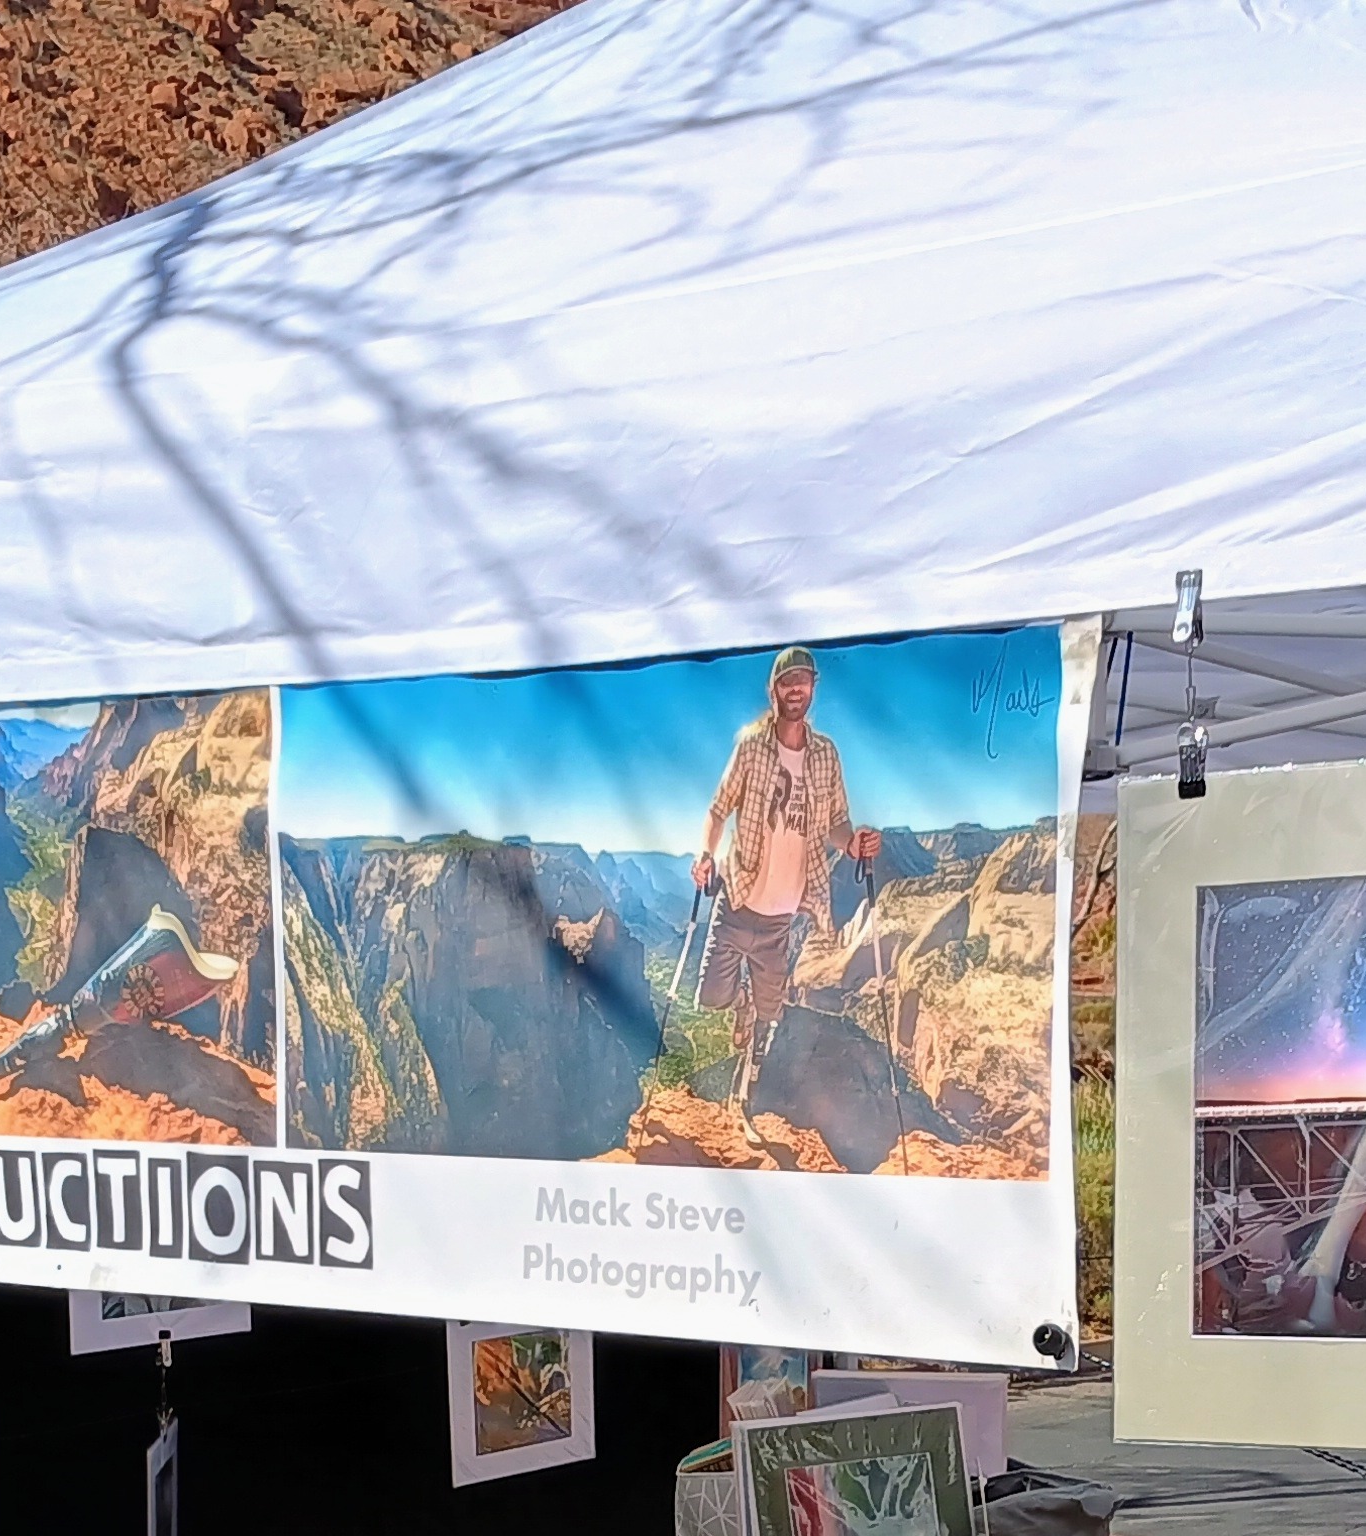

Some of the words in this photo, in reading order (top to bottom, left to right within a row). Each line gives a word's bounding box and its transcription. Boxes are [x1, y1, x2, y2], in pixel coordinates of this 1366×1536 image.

[535, 1186, 632, 1228] Mack
[644, 1191, 746, 1234] Steve
[522, 1242, 762, 1307] Photography
